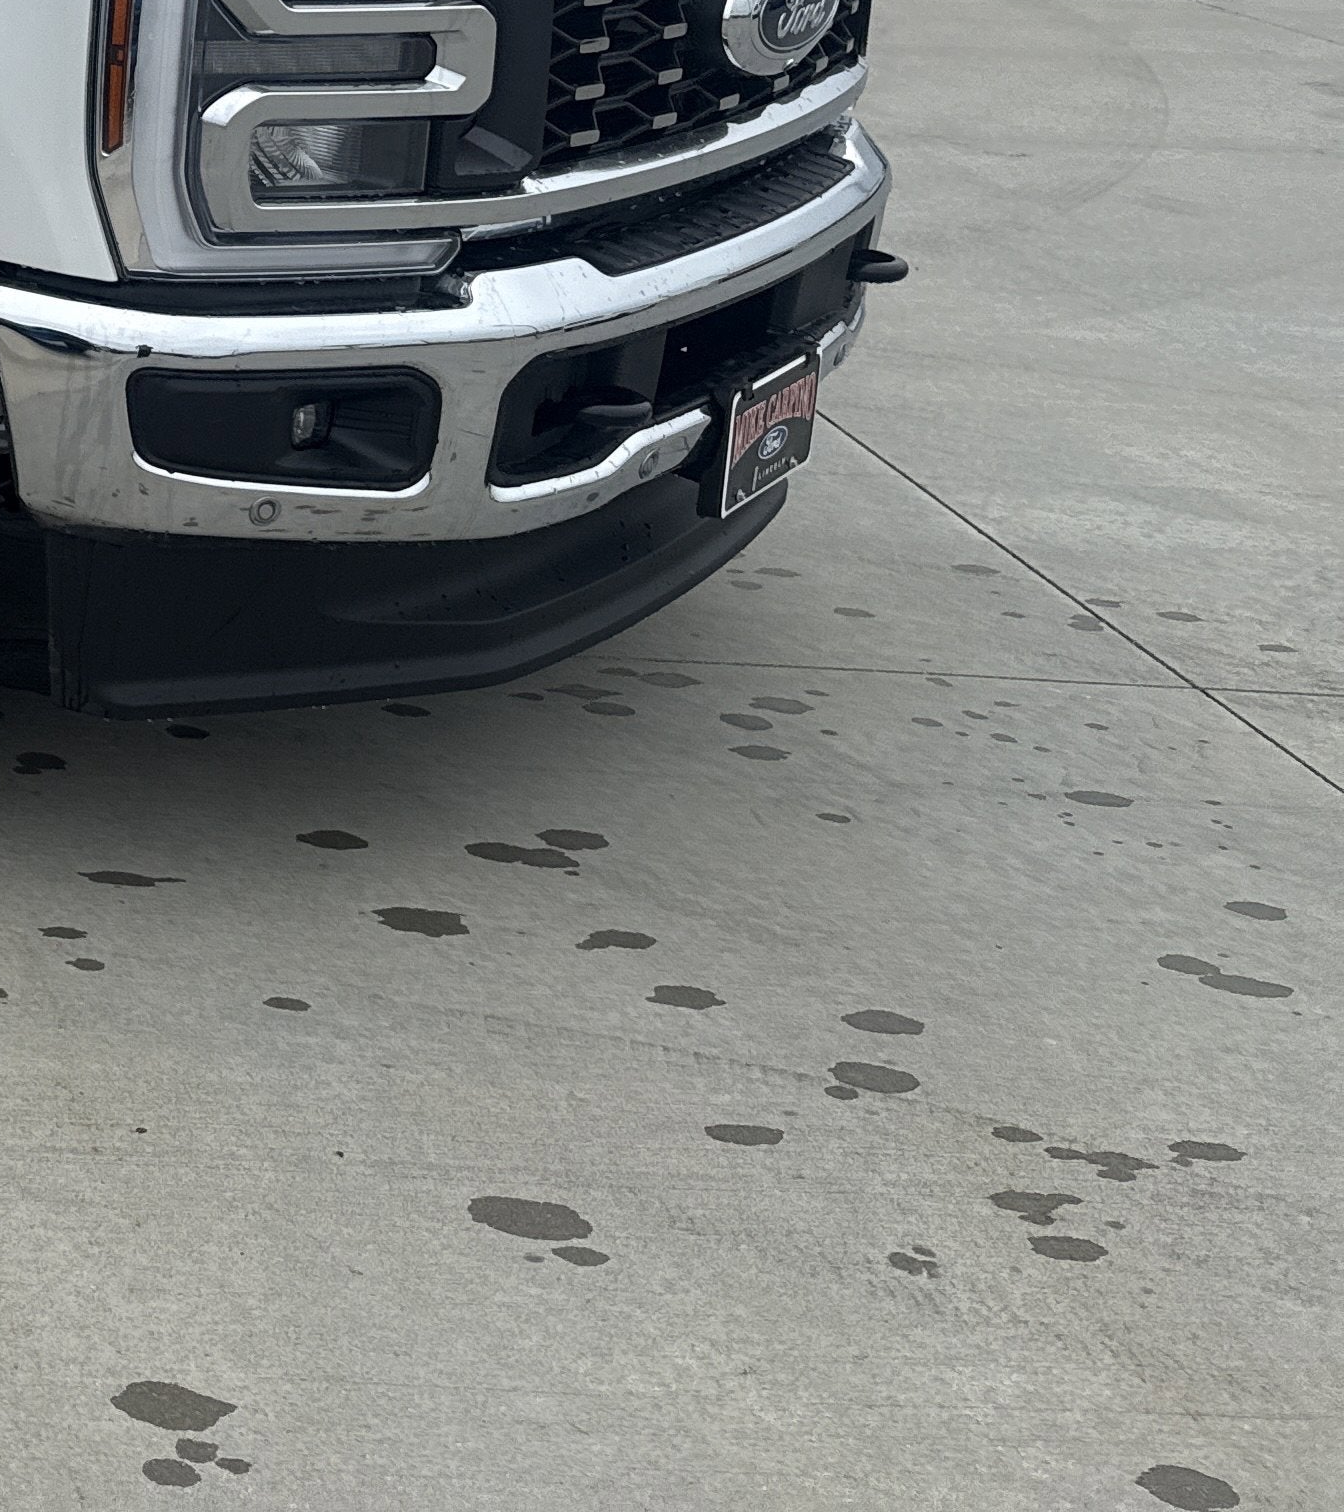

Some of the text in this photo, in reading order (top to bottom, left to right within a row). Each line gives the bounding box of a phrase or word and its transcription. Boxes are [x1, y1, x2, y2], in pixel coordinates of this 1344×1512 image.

[731, 372, 817, 470] MIKE CARPINO
[763, 430, 783, 456] Ford
